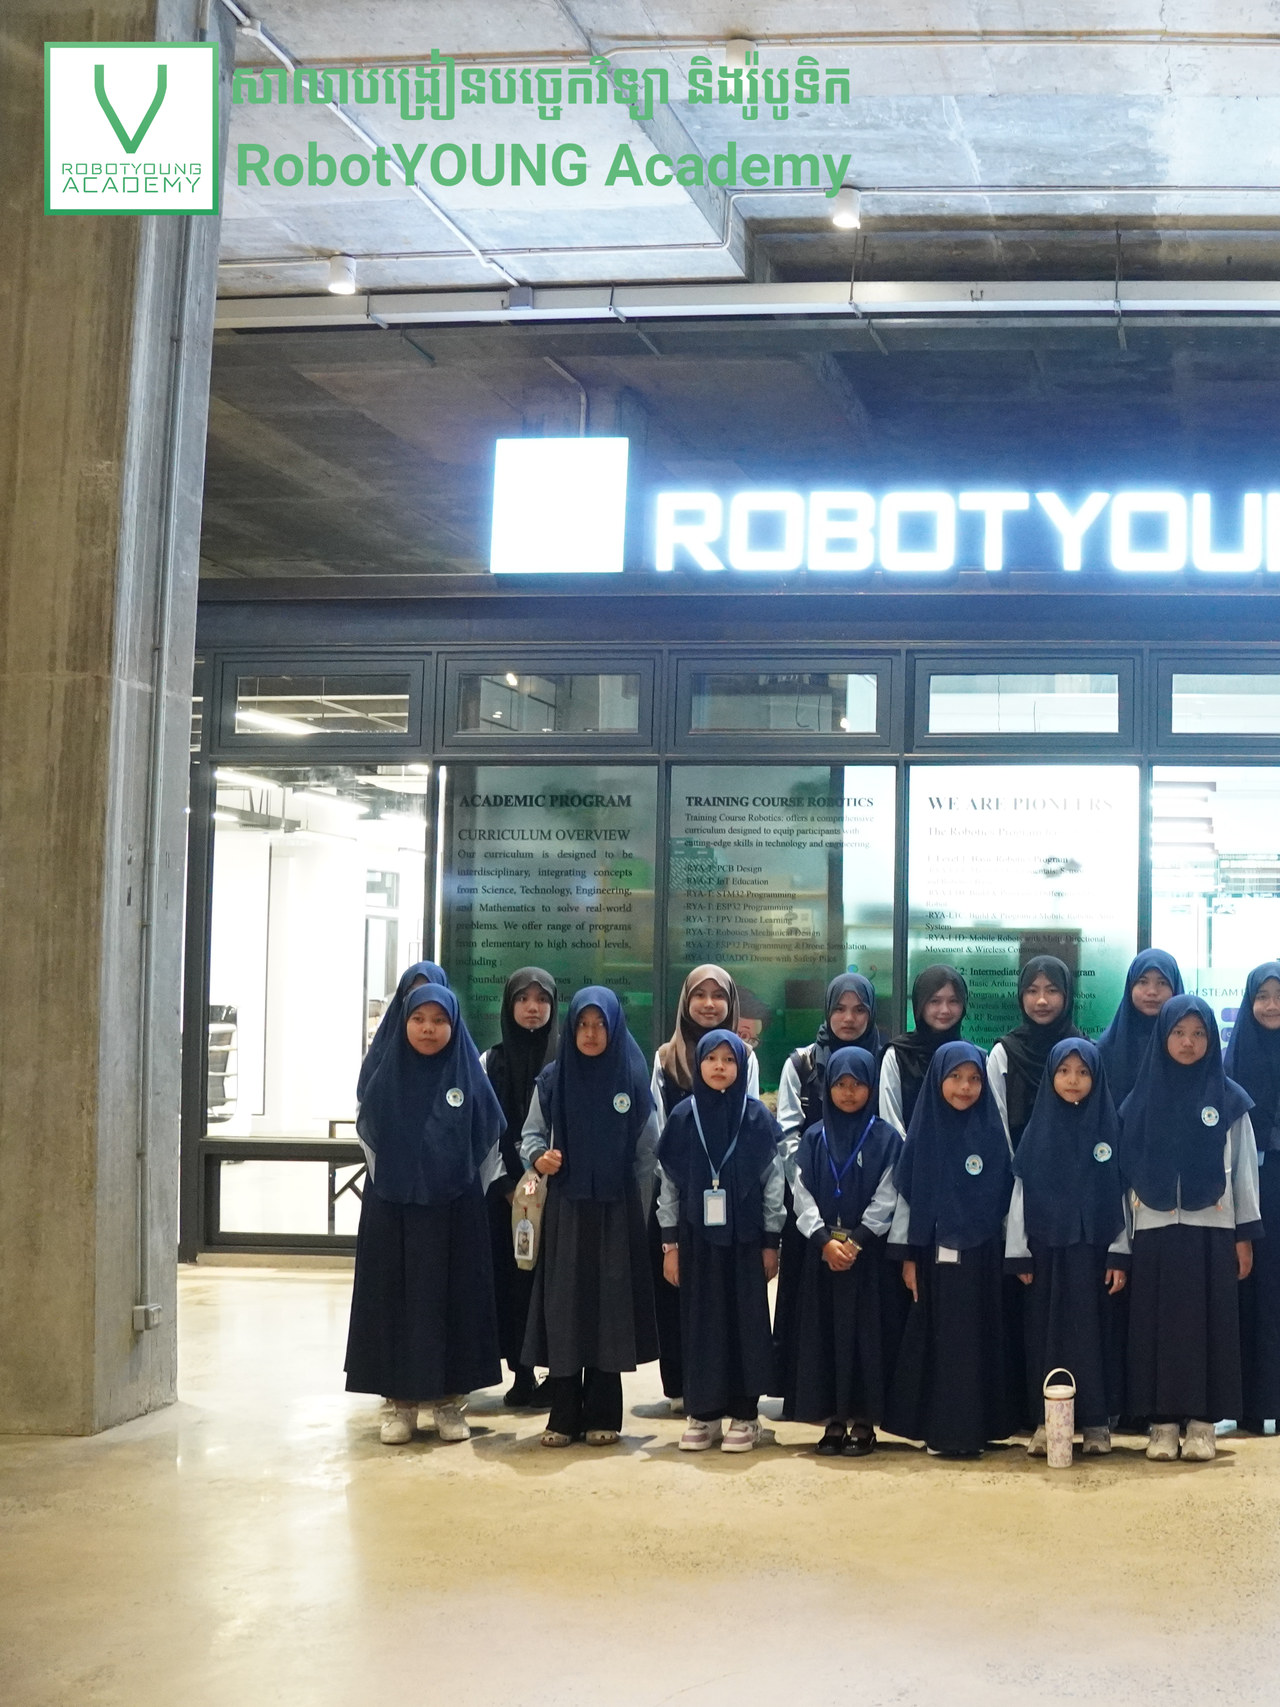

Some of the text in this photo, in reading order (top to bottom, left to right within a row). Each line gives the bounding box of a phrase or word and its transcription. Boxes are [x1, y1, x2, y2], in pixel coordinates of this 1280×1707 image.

[459, 794, 632, 808] ACADEMIC PROGRAM
[685, 796, 874, 807] TRAINING COURSE ROBOTICS
[928, 796, 961, 810] WE
[967, 796, 1004, 811] ARE
[685, 813, 717, 823] Training
[719, 814, 746, 822] Course
[786, 813, 808, 822] offers
[457, 829, 631, 841] CURRICULUM OVERVIEW
[684, 826, 726, 835] curriculum
[727, 826, 762, 837] designed
[763, 827, 772, 835] to
[773, 826, 795, 837] equip
[797, 826, 841, 837] participants
[684, 839, 733, 849] cutting-edge
[733, 839, 754, 847] skills
[755, 839, 763, 847] in
[765, 839, 807, 849] technology
[809, 839, 823, 848] and
[457, 849, 633, 861] Our curriculum is designed to be
[457, 867, 633, 879] interdisciplinary, integrating concepts
[717, 864, 735, 872] PCB
[736, 864, 762, 875] Design
[732, 877, 769, 886] Education
[456, 884, 632, 897] from Science, Technology, Engineering,
[746, 890, 797, 901] Programming
[479, 903, 536, 912] Mathematics
[541, 904, 551, 912] to
[557, 903, 580, 912] solve
[585, 903, 632, 912] real-world
[743, 903, 793, 913] Programming
[716, 915, 732, 924] FPV
[734, 915, 758, 924] Drone
[759, 915, 793, 925] Learning
[503, 921, 519, 930] We
[521, 920, 543, 930] offer
[546, 922, 572, 933] range
[575, 921, 585, 930] of
[588, 922, 632, 933] programs
[925, 922, 952, 932] System
[715, 928, 749, 937] Robotics
[750, 928, 793, 937] Mechanical
[969, 934, 995, 942] Mobile
[997, 934, 1022, 943] Robots
[481, 939, 531, 951] elementary
[534, 940, 543, 948] to
[547, 939, 568, 951] high
[571, 939, 601, 949] school
[742, 942, 793, 952] Programming
[925, 946, 964, 954] Movement
[965, 946, 973, 954] &
[975, 946, 1006, 954] Wireless
[969, 979, 988, 987] Basic
